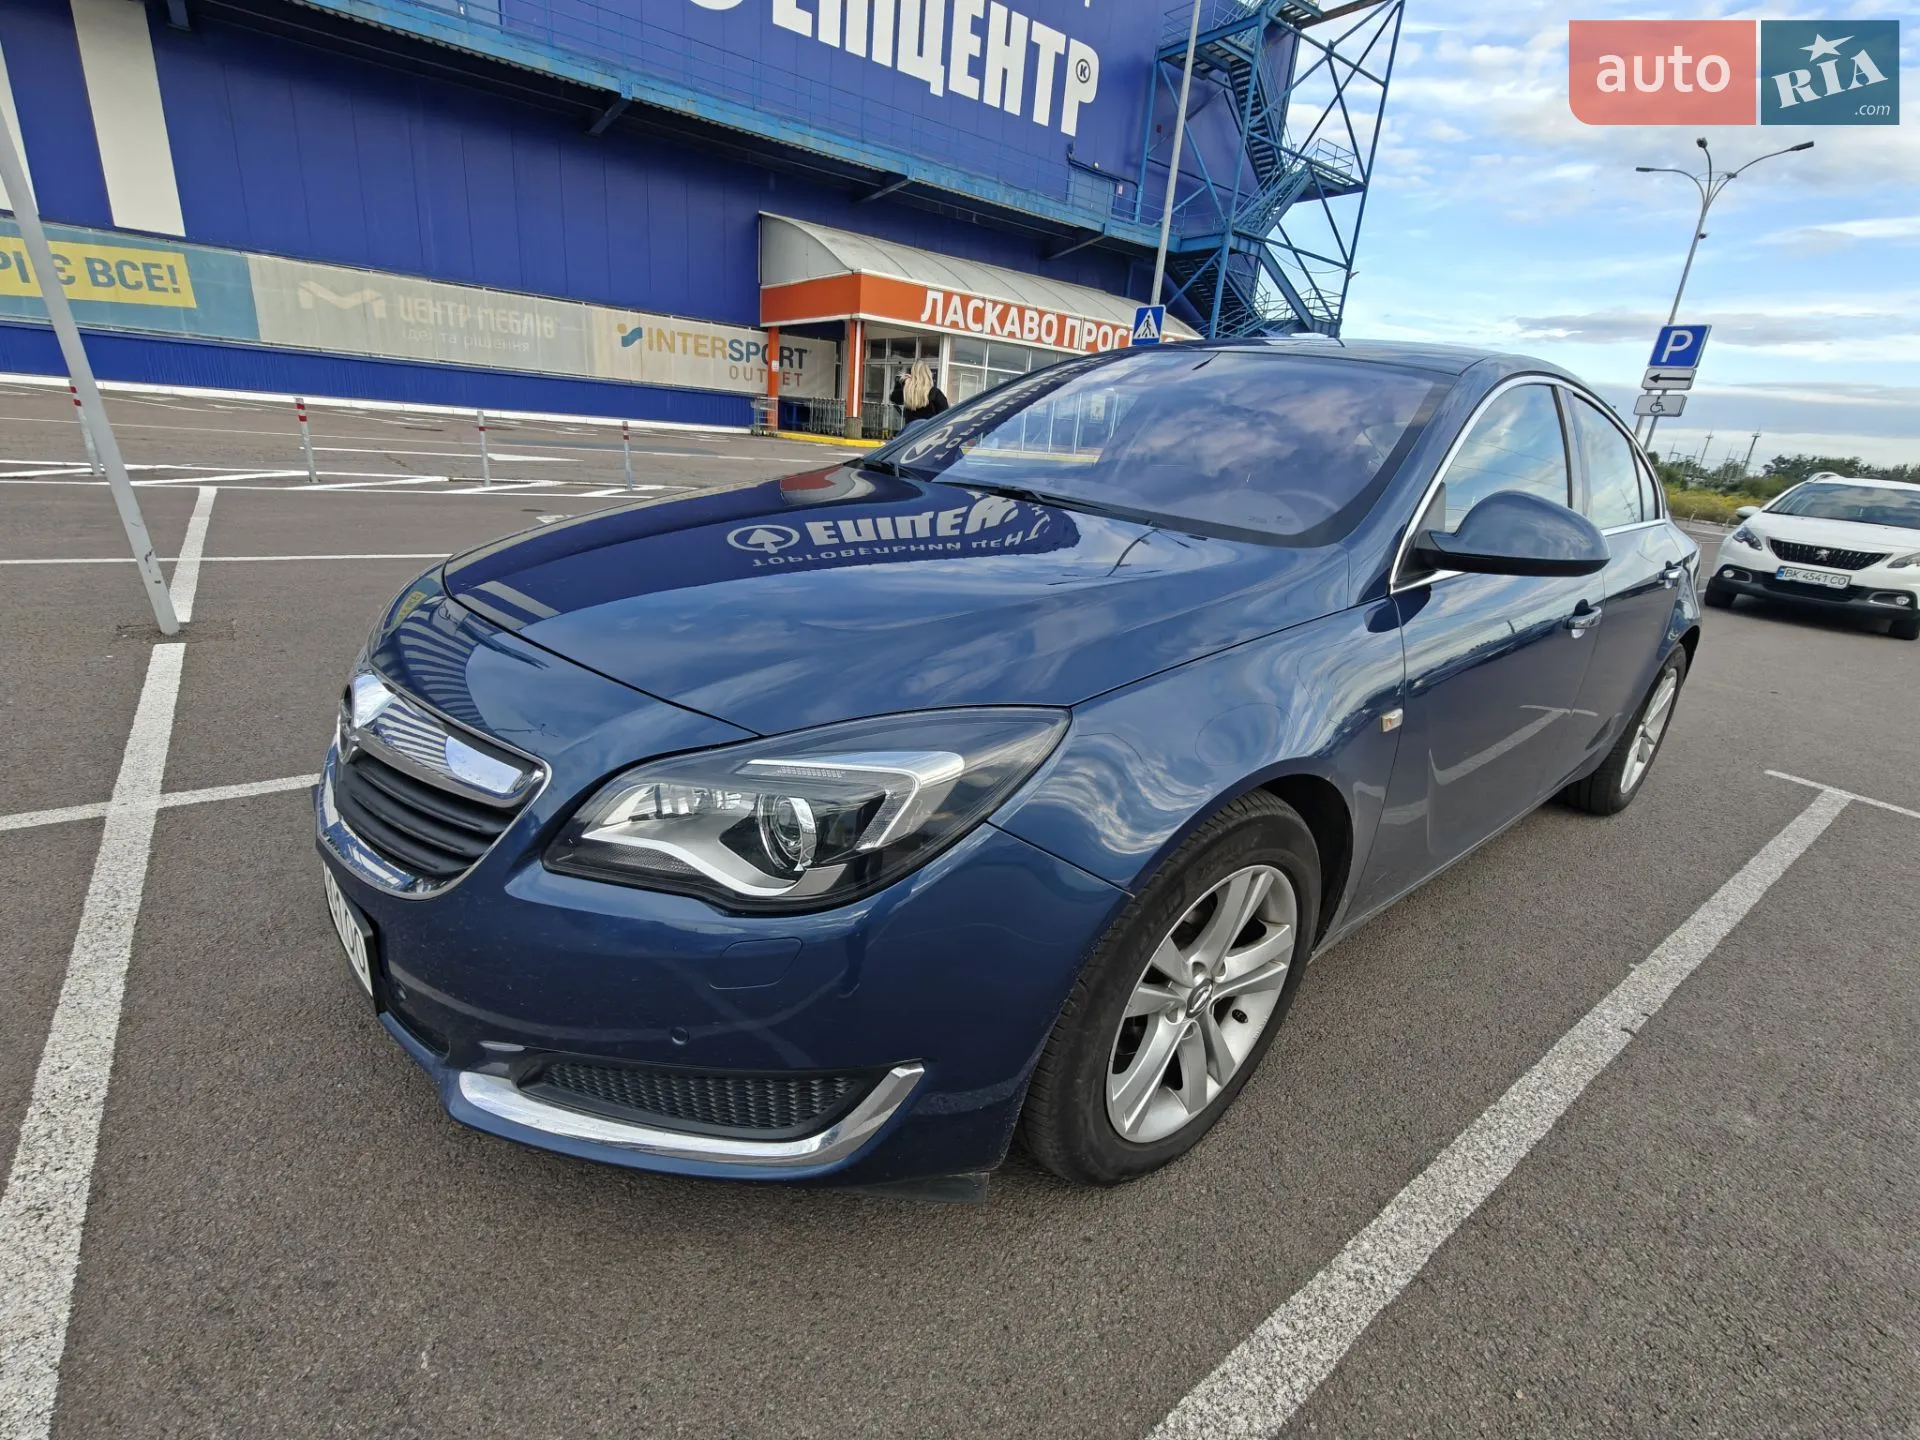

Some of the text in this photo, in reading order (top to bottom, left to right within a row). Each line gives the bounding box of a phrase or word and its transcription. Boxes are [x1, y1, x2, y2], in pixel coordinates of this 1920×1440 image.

[84, 256, 181, 293] ВСЕ!
[920, 290, 1057, 344] ЛАСКАВО
[1660, 329, 1694, 363] P
[729, 365, 803, 388] OUTET
